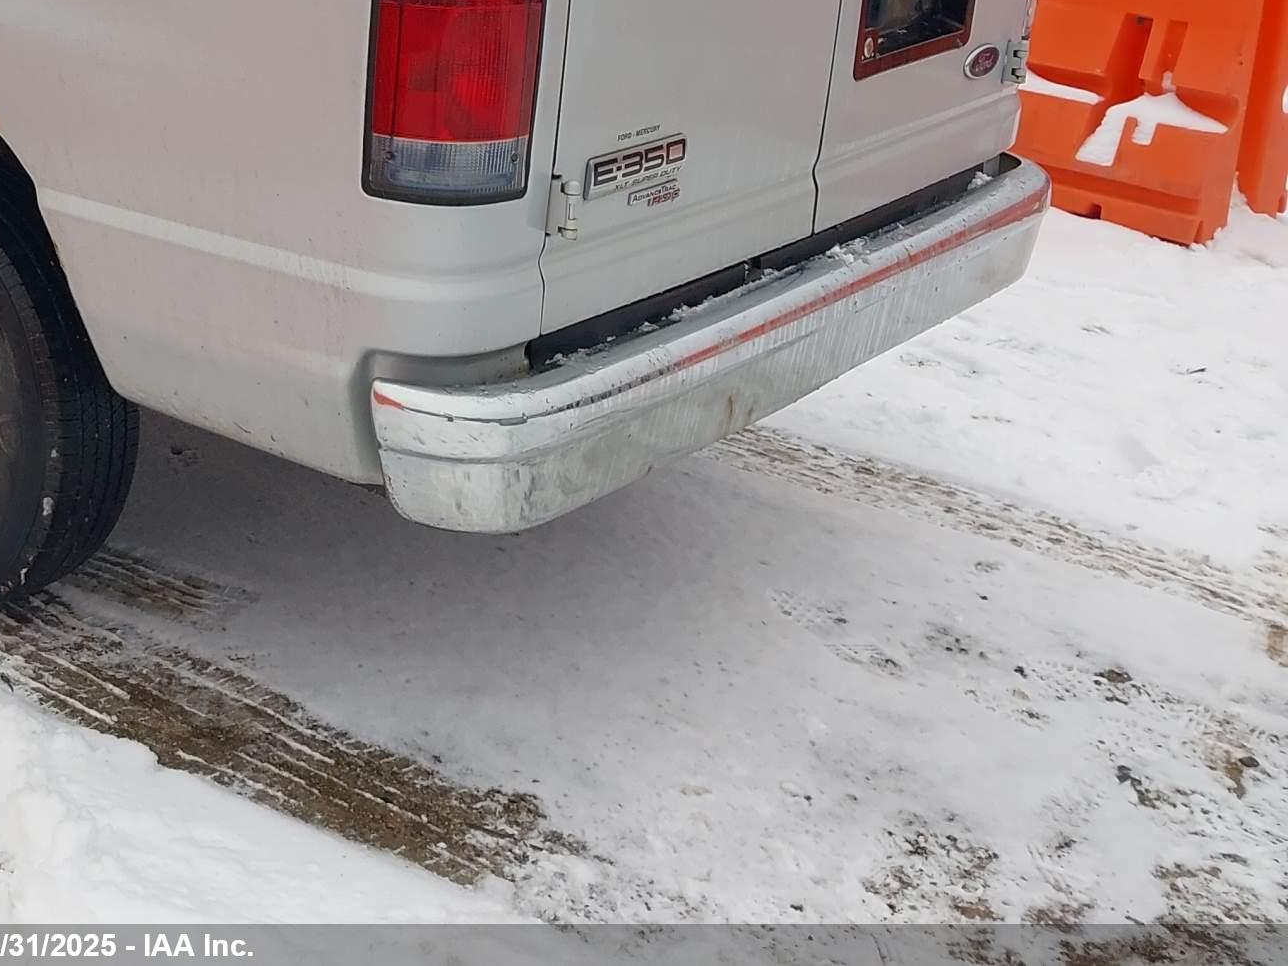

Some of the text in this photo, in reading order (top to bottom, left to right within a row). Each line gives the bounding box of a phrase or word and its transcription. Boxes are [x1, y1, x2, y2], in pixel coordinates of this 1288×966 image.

[617, 132, 632, 141] FORD
[636, 124, 660, 136] MERCURY
[594, 138, 686, 186] E-350
[615, 165, 682, 190] XLT SUPER DUTY
